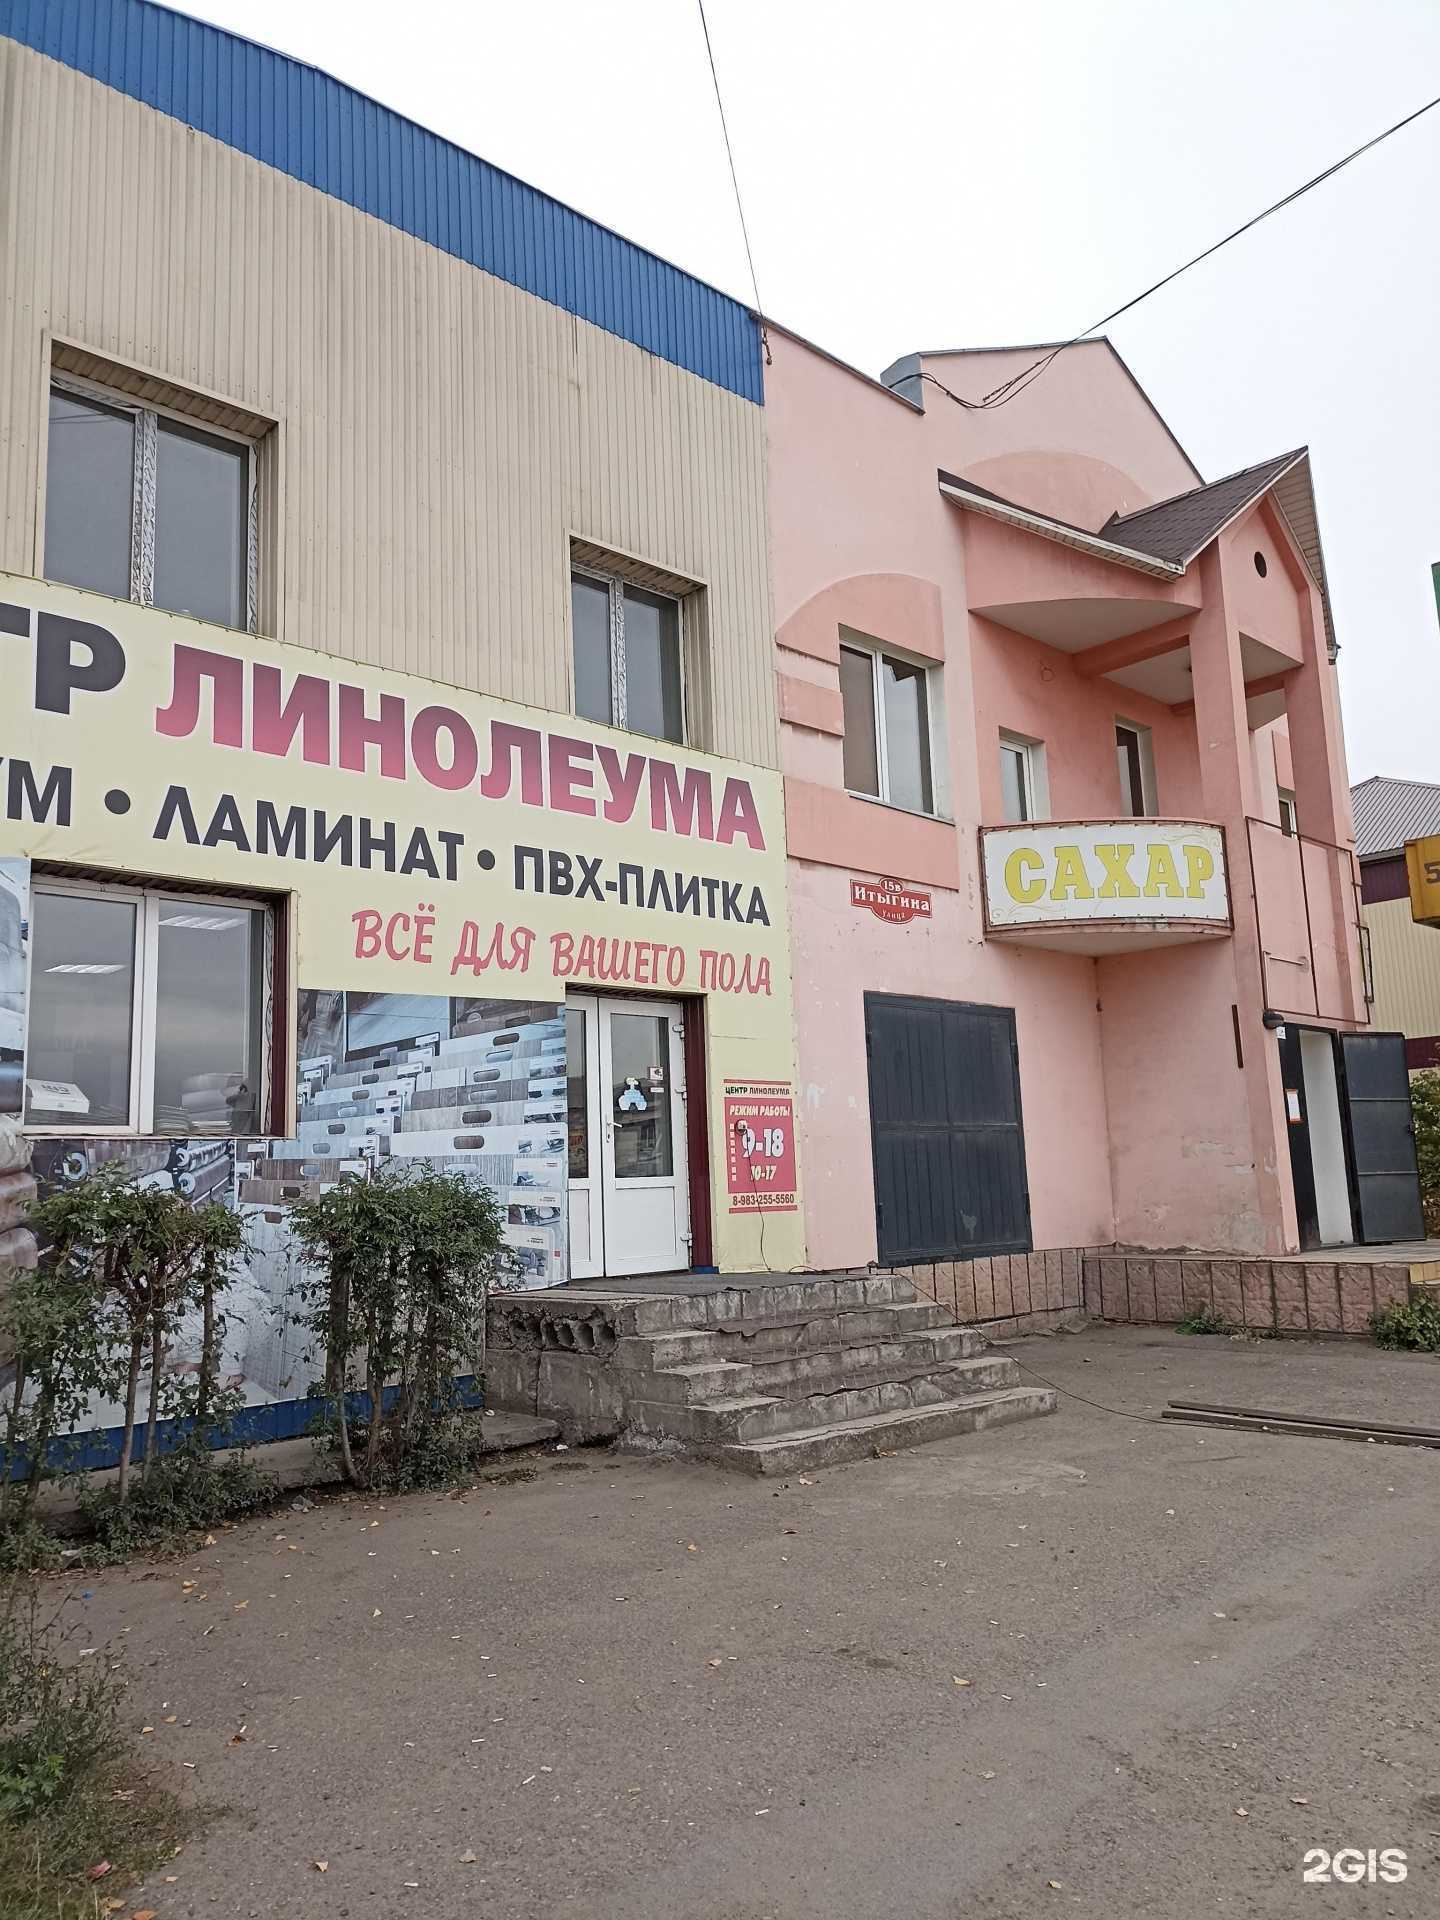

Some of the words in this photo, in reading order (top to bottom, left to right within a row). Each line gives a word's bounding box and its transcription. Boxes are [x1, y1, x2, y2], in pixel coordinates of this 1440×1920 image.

[155, 642, 767, 852] ЛИНОЛЕУМА
[0, 756, 73, 827] М
[152, 784, 465, 882] ЛАМИНАТ
[514, 844, 771, 927] ПВХ-ПЛИТКА
[854, 885, 931, 911] Итыгина
[1004, 843, 1215, 904] САХАР
[351, 903, 436, 964] ВСЁ
[450, 920, 537, 977] ДЛЯ
[550, 932, 686, 987] ВАШЕГО
[700, 949, 772, 996] ПОЛА
[725, 1086, 748, 1094] ЦЕНТР
[749, 1087, 790, 1095] ЛИНОЛЕУМА
[729, 1105, 759, 1116] РЕЖИМ
[760, 1105, 791, 1117] РАБОТЫ
